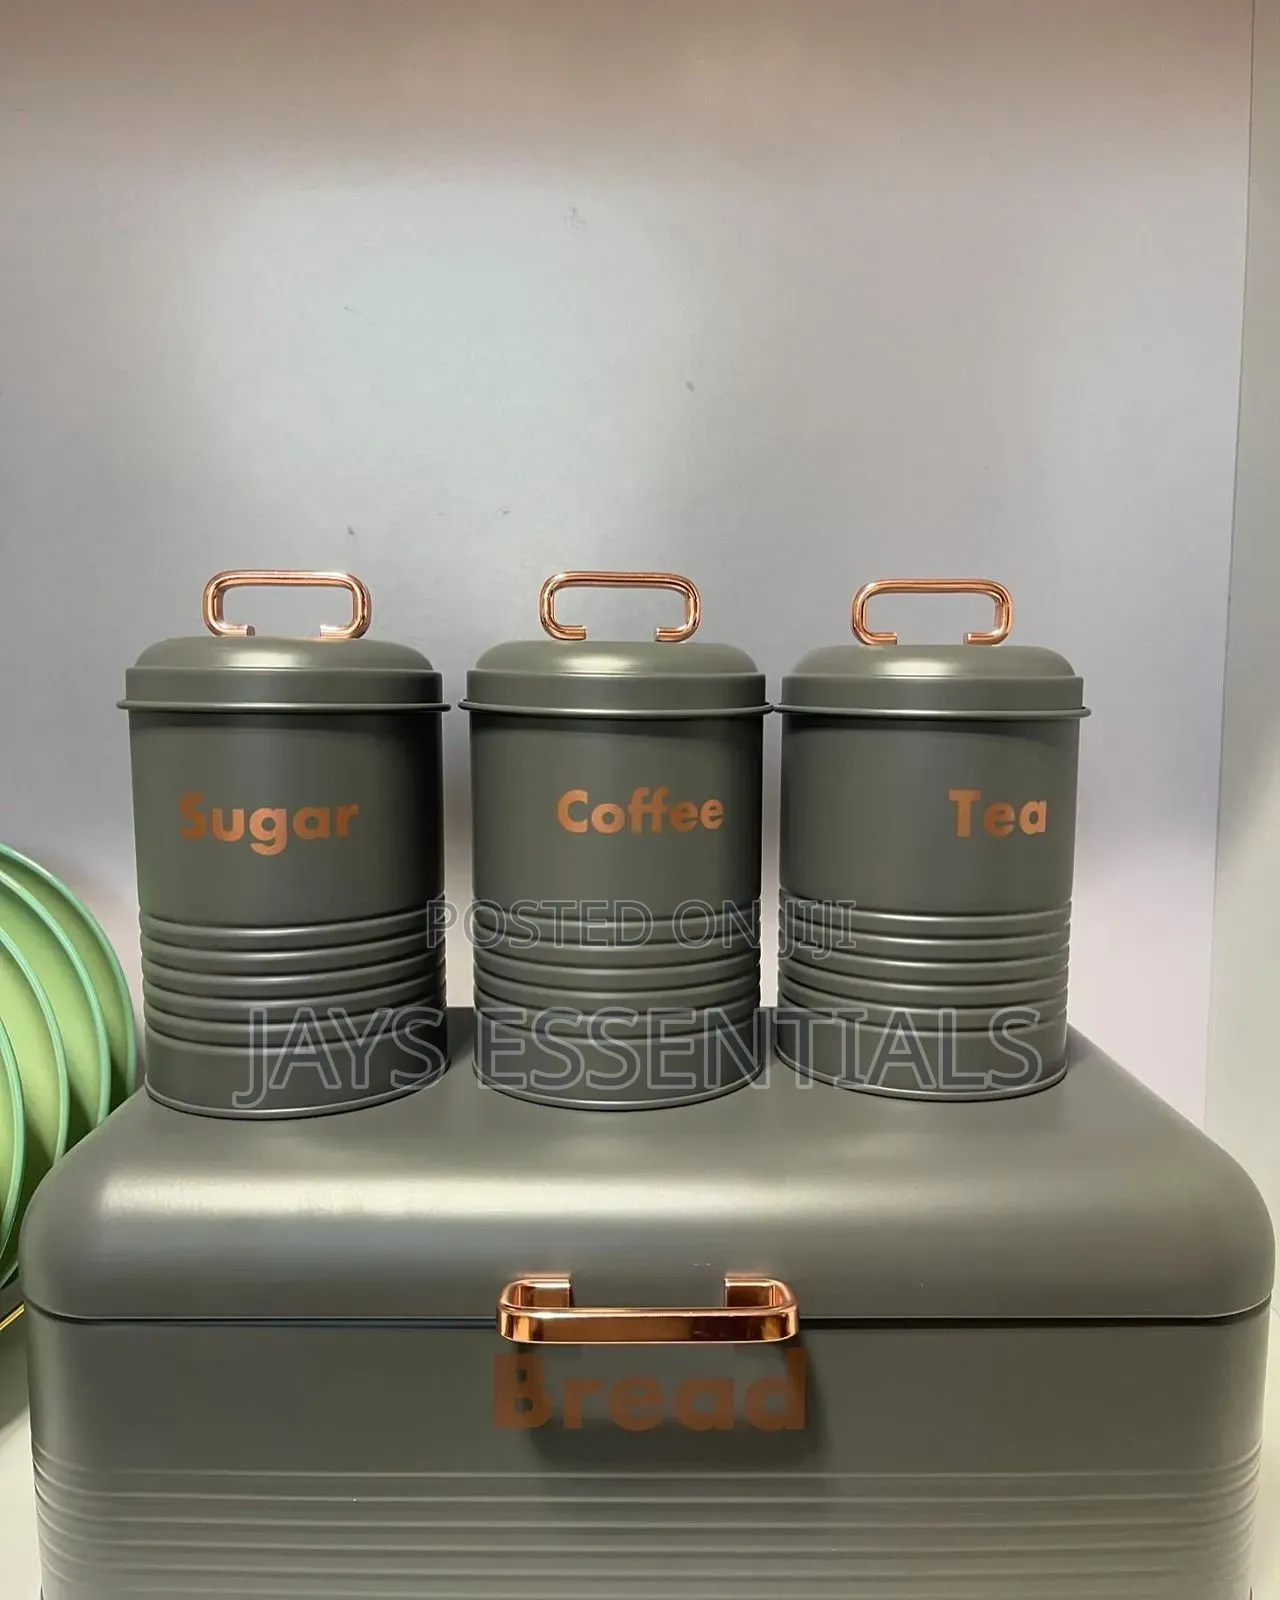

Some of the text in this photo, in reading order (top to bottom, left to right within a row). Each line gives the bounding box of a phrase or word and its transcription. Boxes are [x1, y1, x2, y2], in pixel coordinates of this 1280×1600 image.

[178, 792, 359, 856] Sugar
[557, 786, 725, 835] Coffee
[949, 788, 1047, 838] Tea
[493, 1346, 809, 1432] Bread
